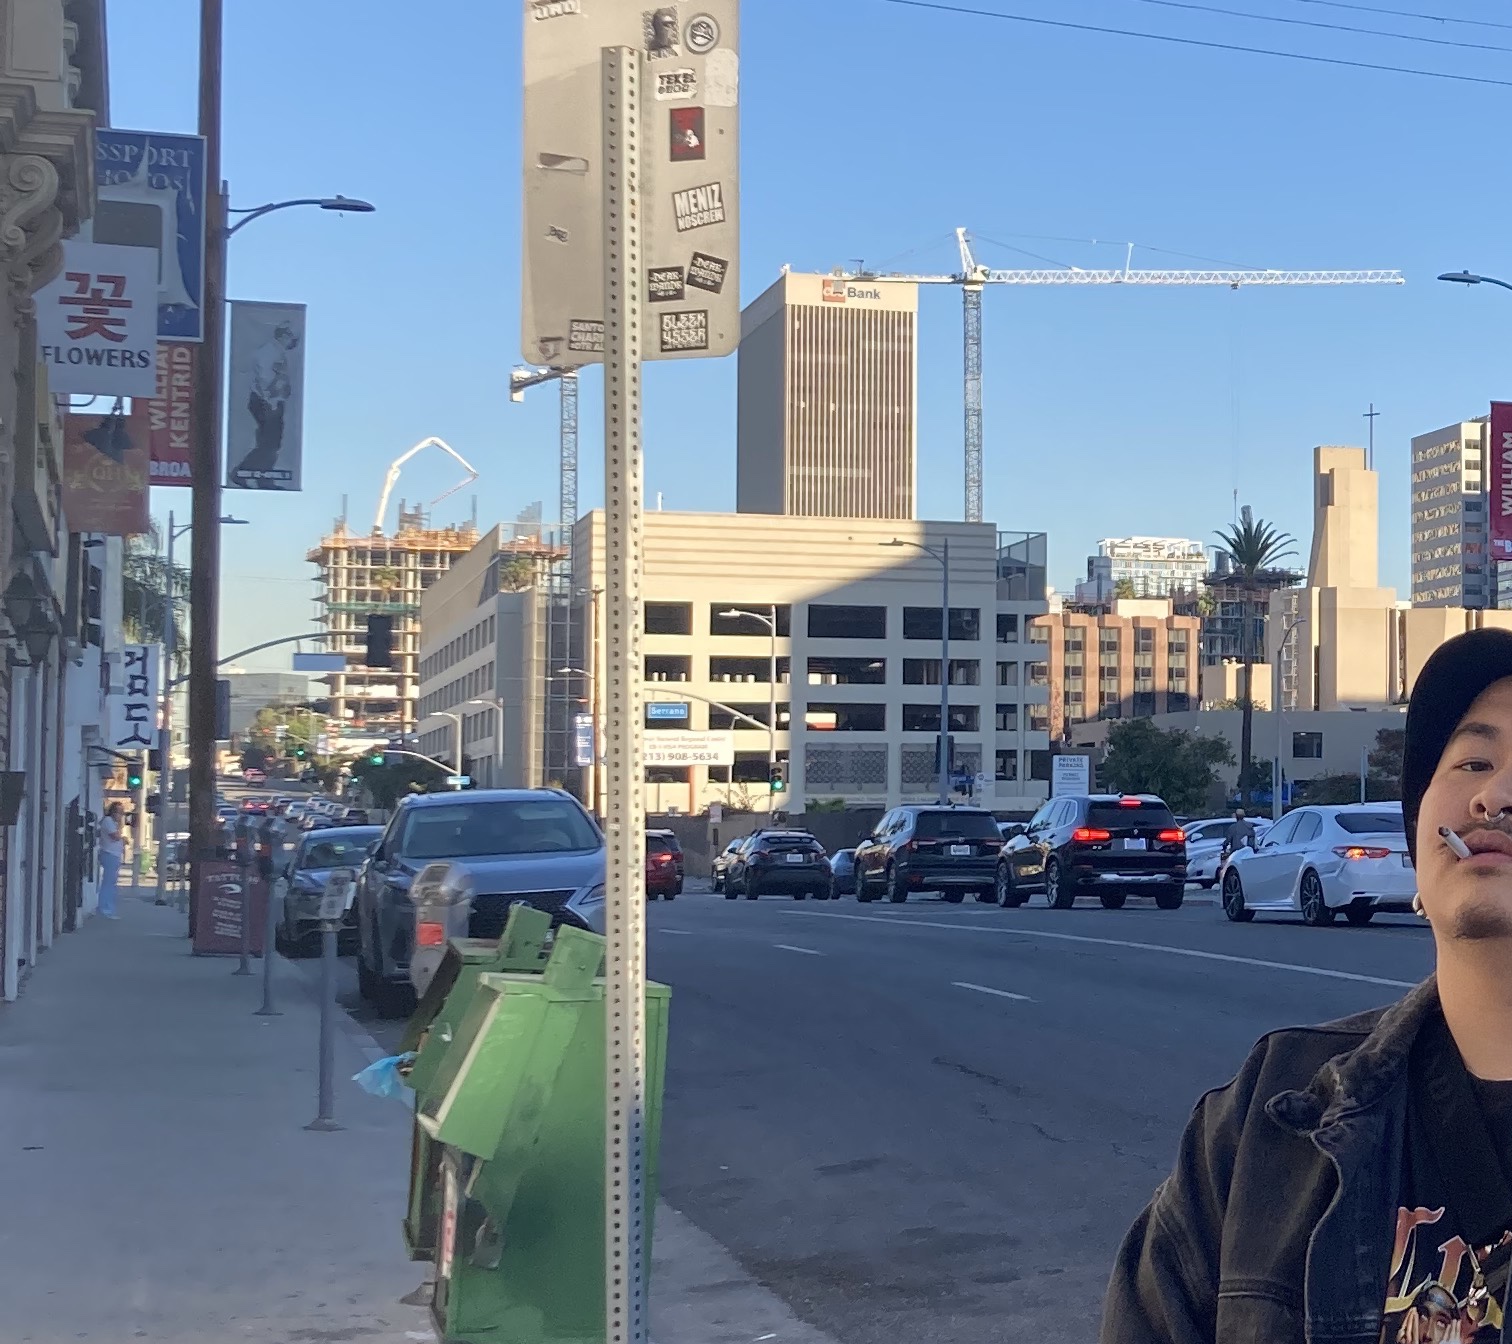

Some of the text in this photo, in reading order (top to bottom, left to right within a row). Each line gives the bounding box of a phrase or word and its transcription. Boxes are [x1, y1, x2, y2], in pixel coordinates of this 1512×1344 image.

[847, 287, 881, 299] Bank
[58, 271, 133, 343] 꽃
[41, 345, 151, 368] FLOWERS
